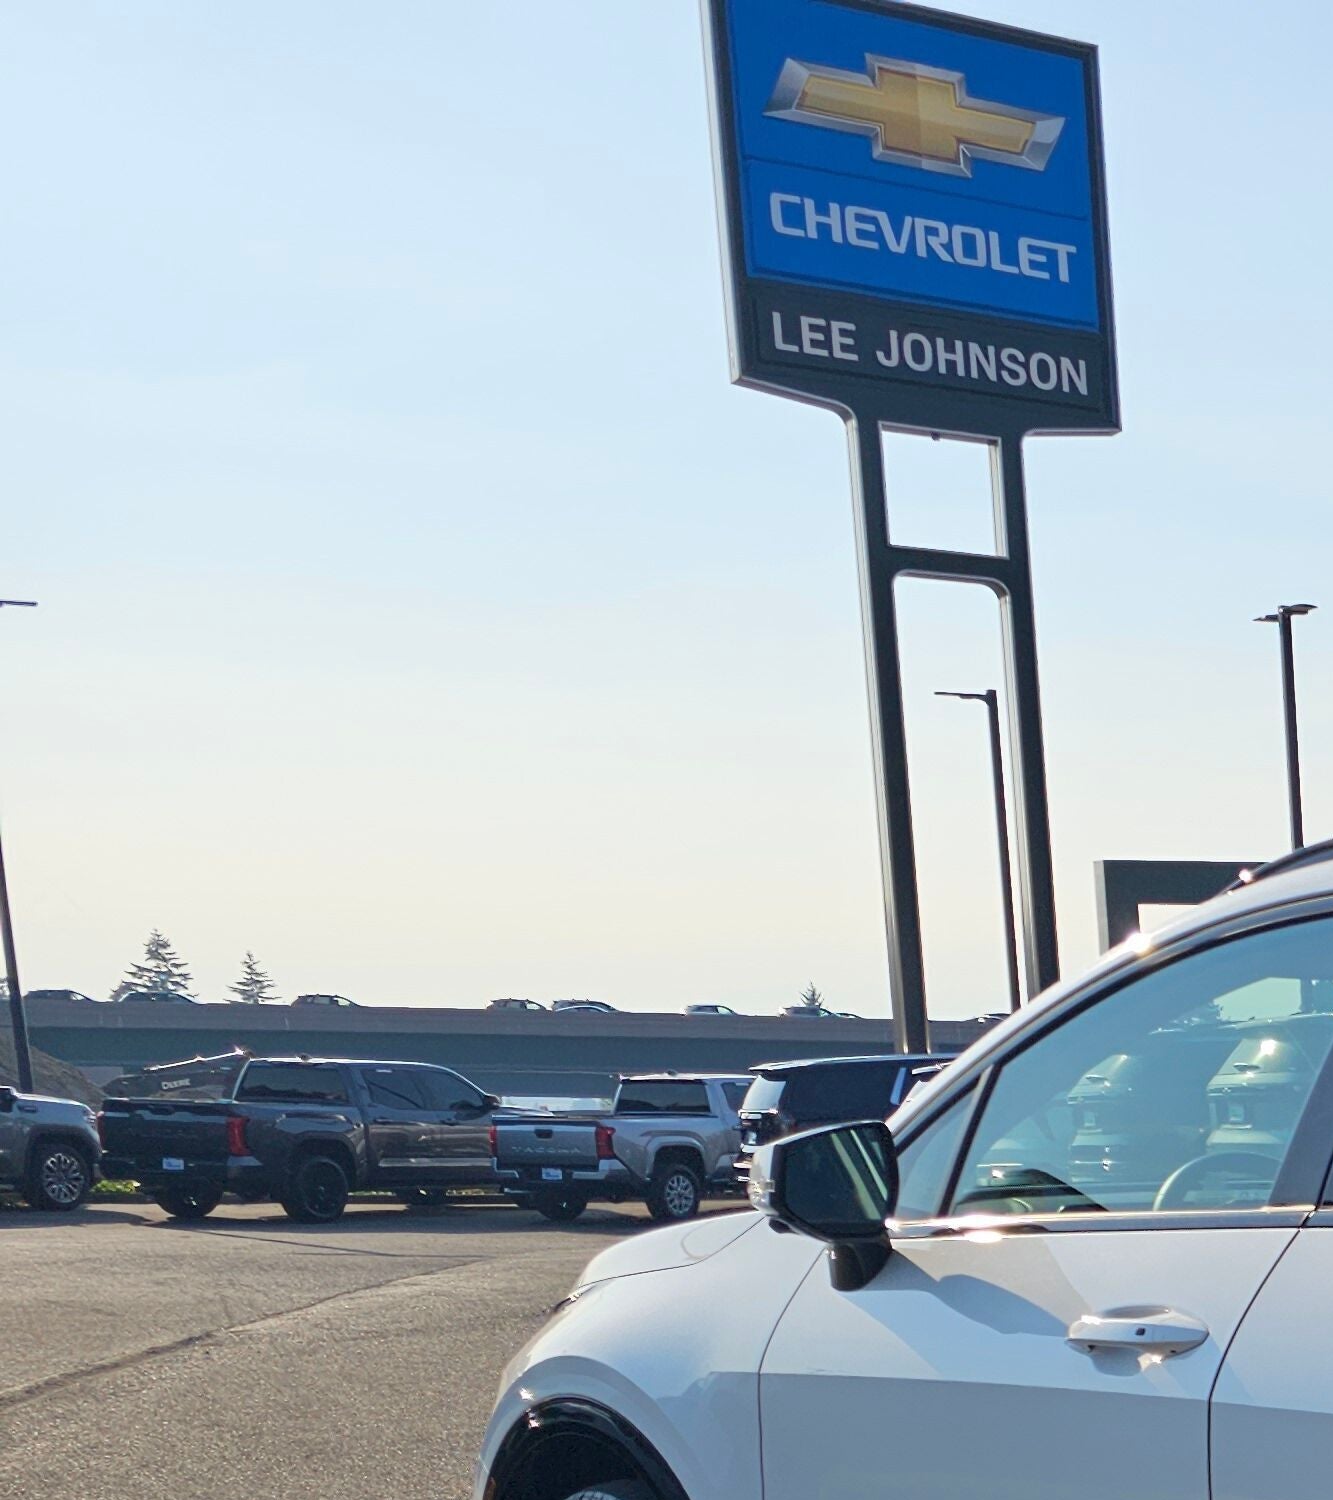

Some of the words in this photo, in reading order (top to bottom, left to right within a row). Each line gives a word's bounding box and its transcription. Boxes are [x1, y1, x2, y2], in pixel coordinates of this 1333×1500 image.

[769, 192, 1077, 283] CHEVROLET
[772, 311, 859, 361] LEE
[876, 330, 1088, 395] JOHNSON
